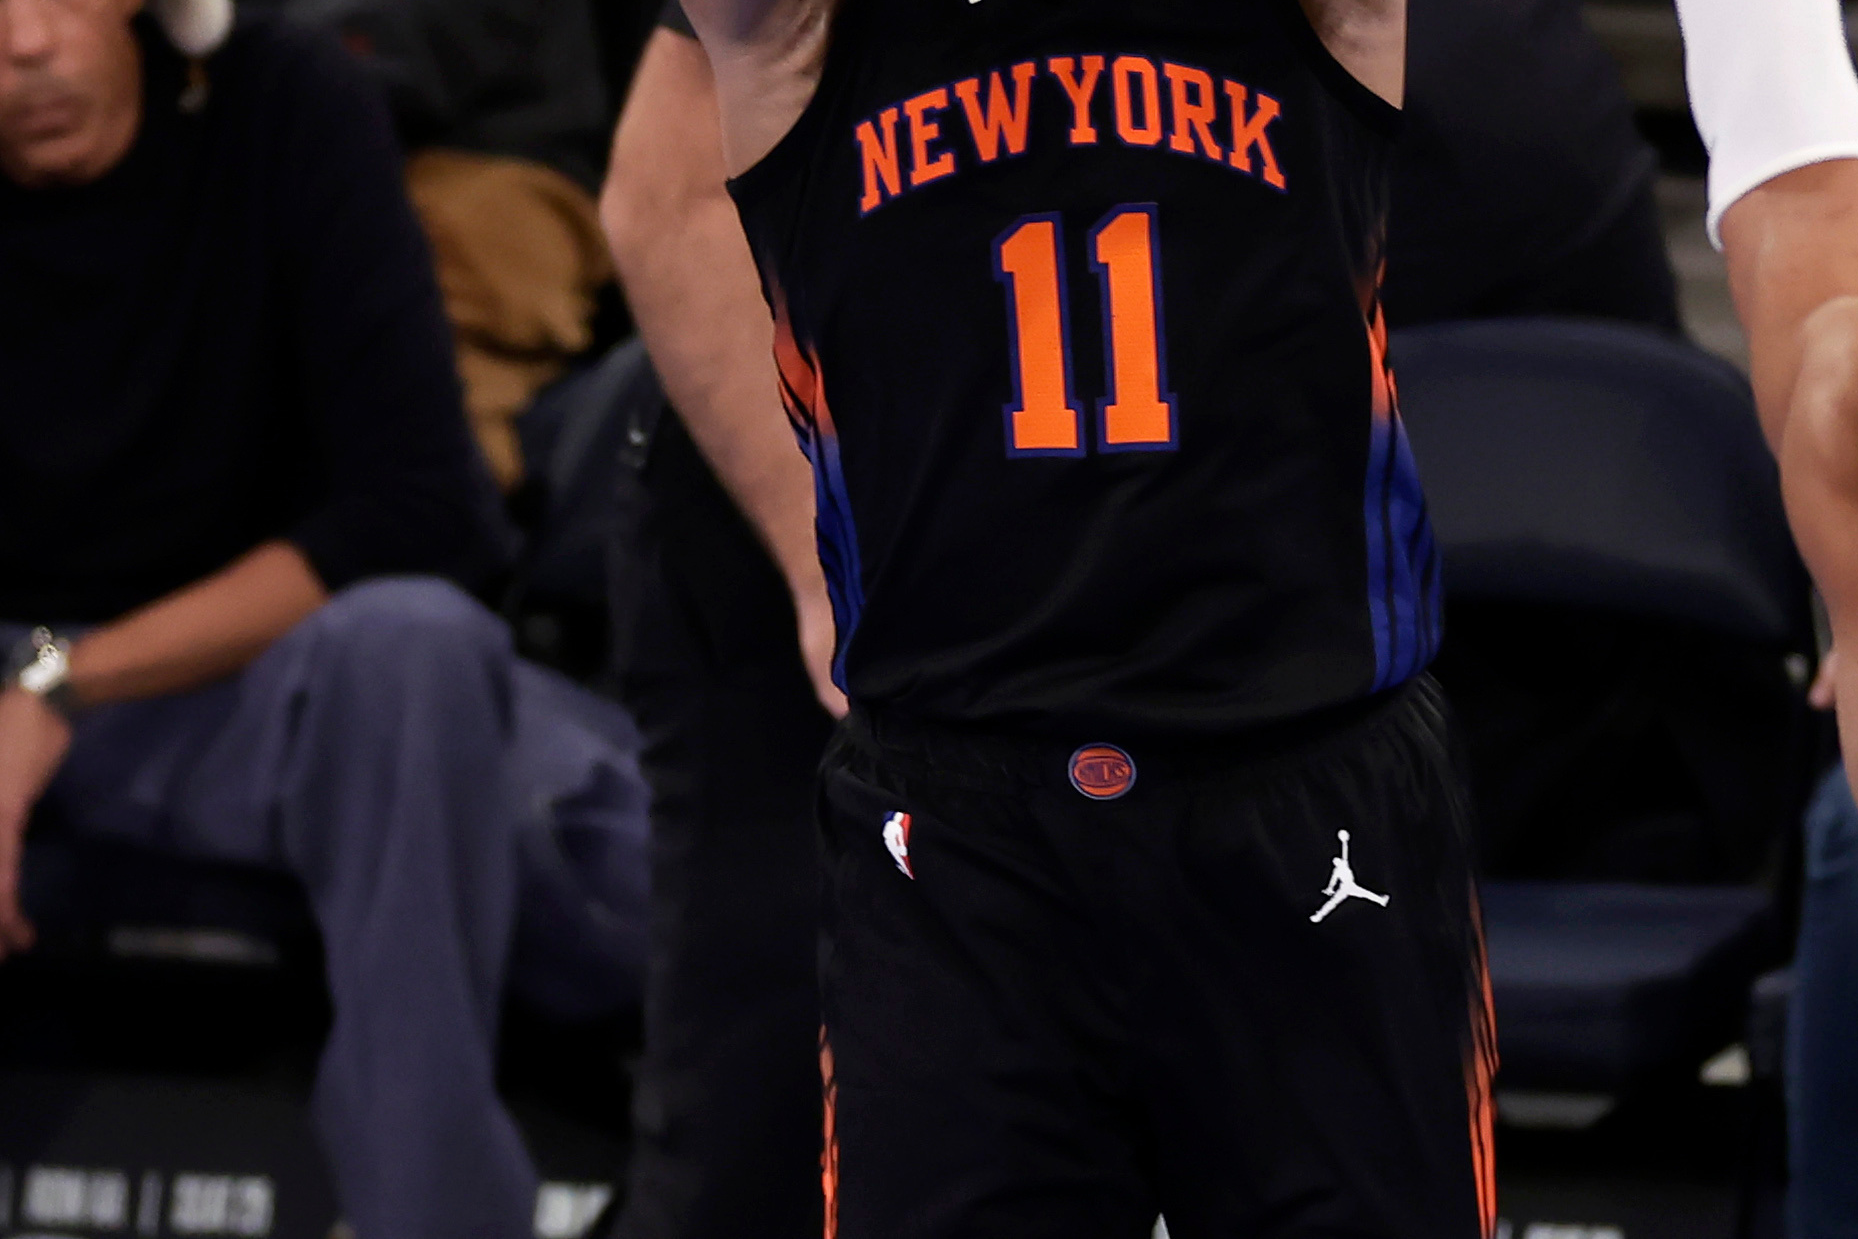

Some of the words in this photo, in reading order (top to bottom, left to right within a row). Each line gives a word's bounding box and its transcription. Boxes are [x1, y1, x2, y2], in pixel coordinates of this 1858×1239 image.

[855, 62, 1037, 217] NEW
[1048, 54, 1289, 193] YORK
[992, 202, 1179, 458] 11
